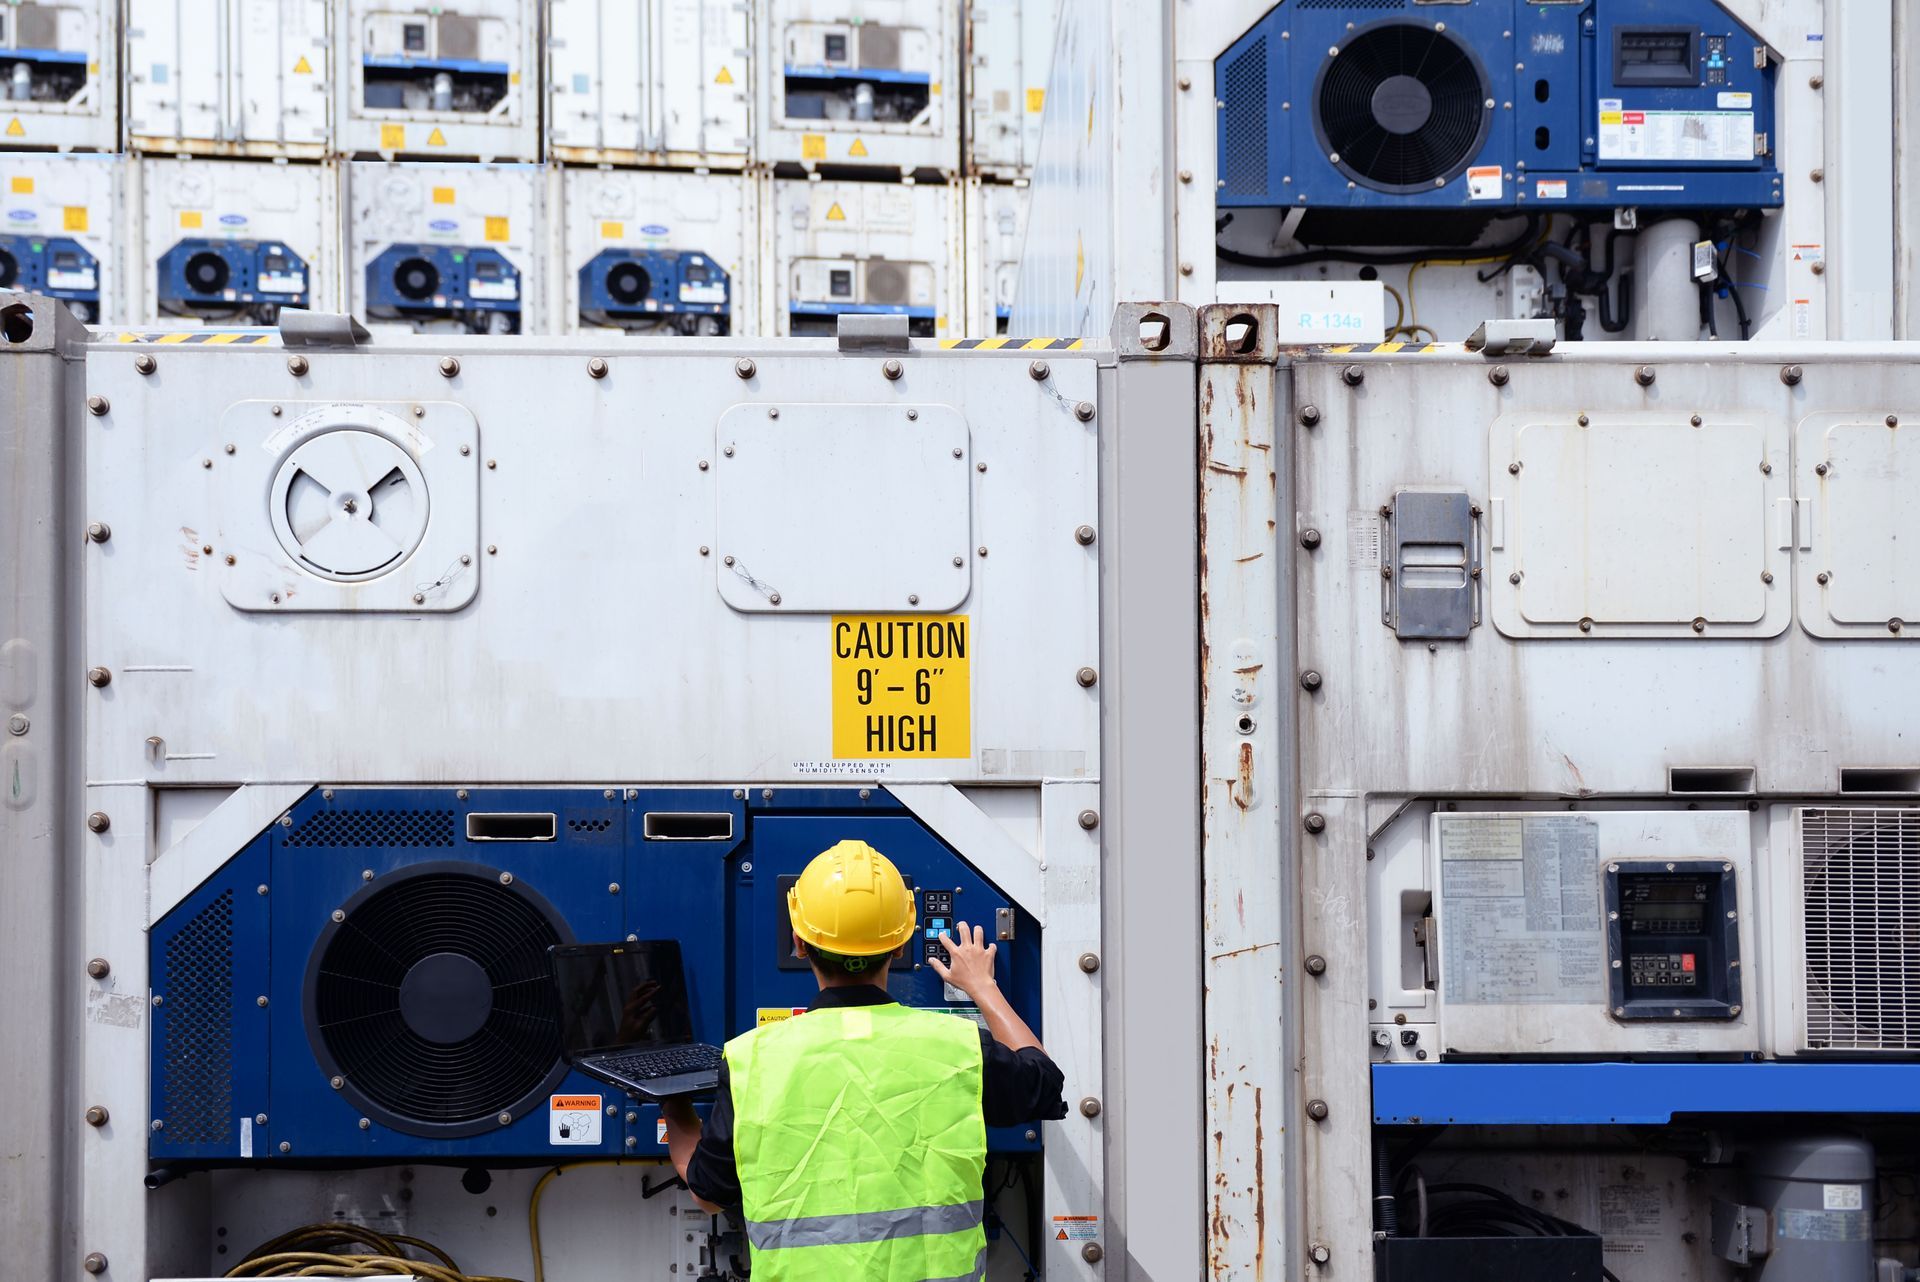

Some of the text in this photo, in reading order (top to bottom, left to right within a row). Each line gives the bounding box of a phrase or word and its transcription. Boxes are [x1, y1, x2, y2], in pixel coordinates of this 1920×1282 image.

[835, 622, 965, 659] CAUTION
[857, 668, 880, 705] 9'
[866, 715, 937, 752] HIGH
